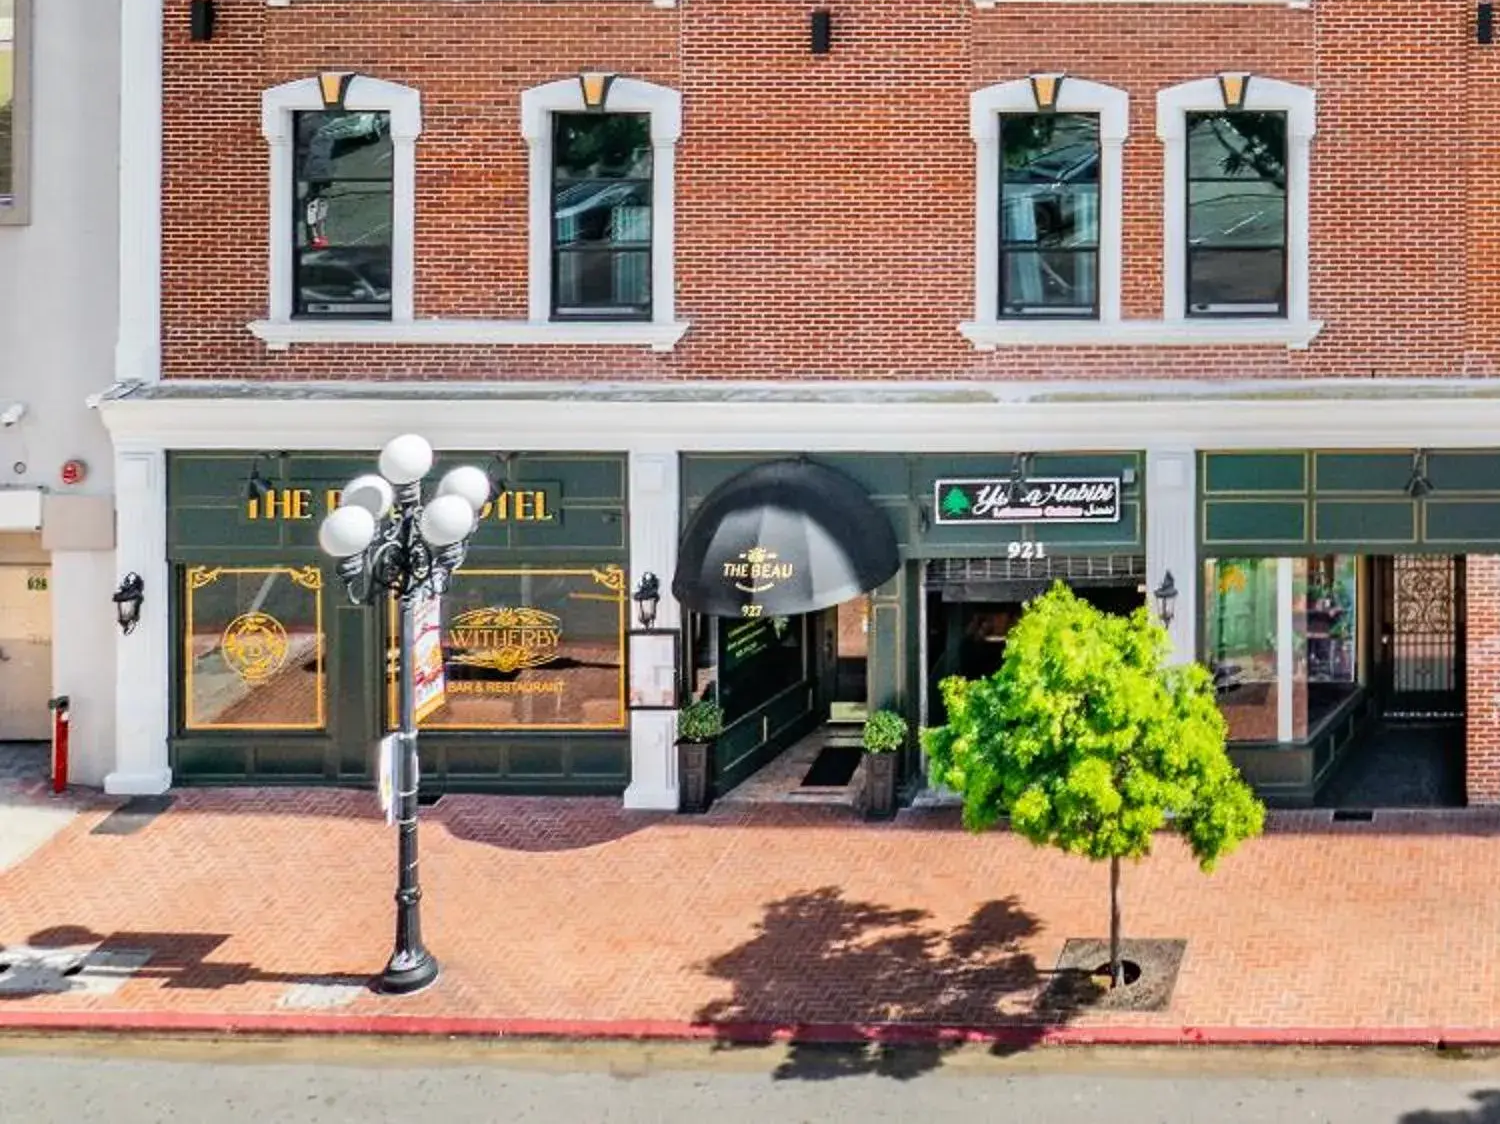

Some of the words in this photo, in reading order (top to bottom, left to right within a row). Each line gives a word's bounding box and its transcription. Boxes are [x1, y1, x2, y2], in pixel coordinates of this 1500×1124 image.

[1032, 483, 1114, 506] Habibi
[1007, 542, 1047, 559] 921
[724, 563, 749, 577] THE
[751, 563, 793, 579] BEAU
[741, 604, 764, 617] 927
[449, 629, 562, 648] WITHERBY
[447, 681, 473, 693] BAR
[475, 682, 485, 693] &
[487, 681, 564, 693] RESTAURANT
